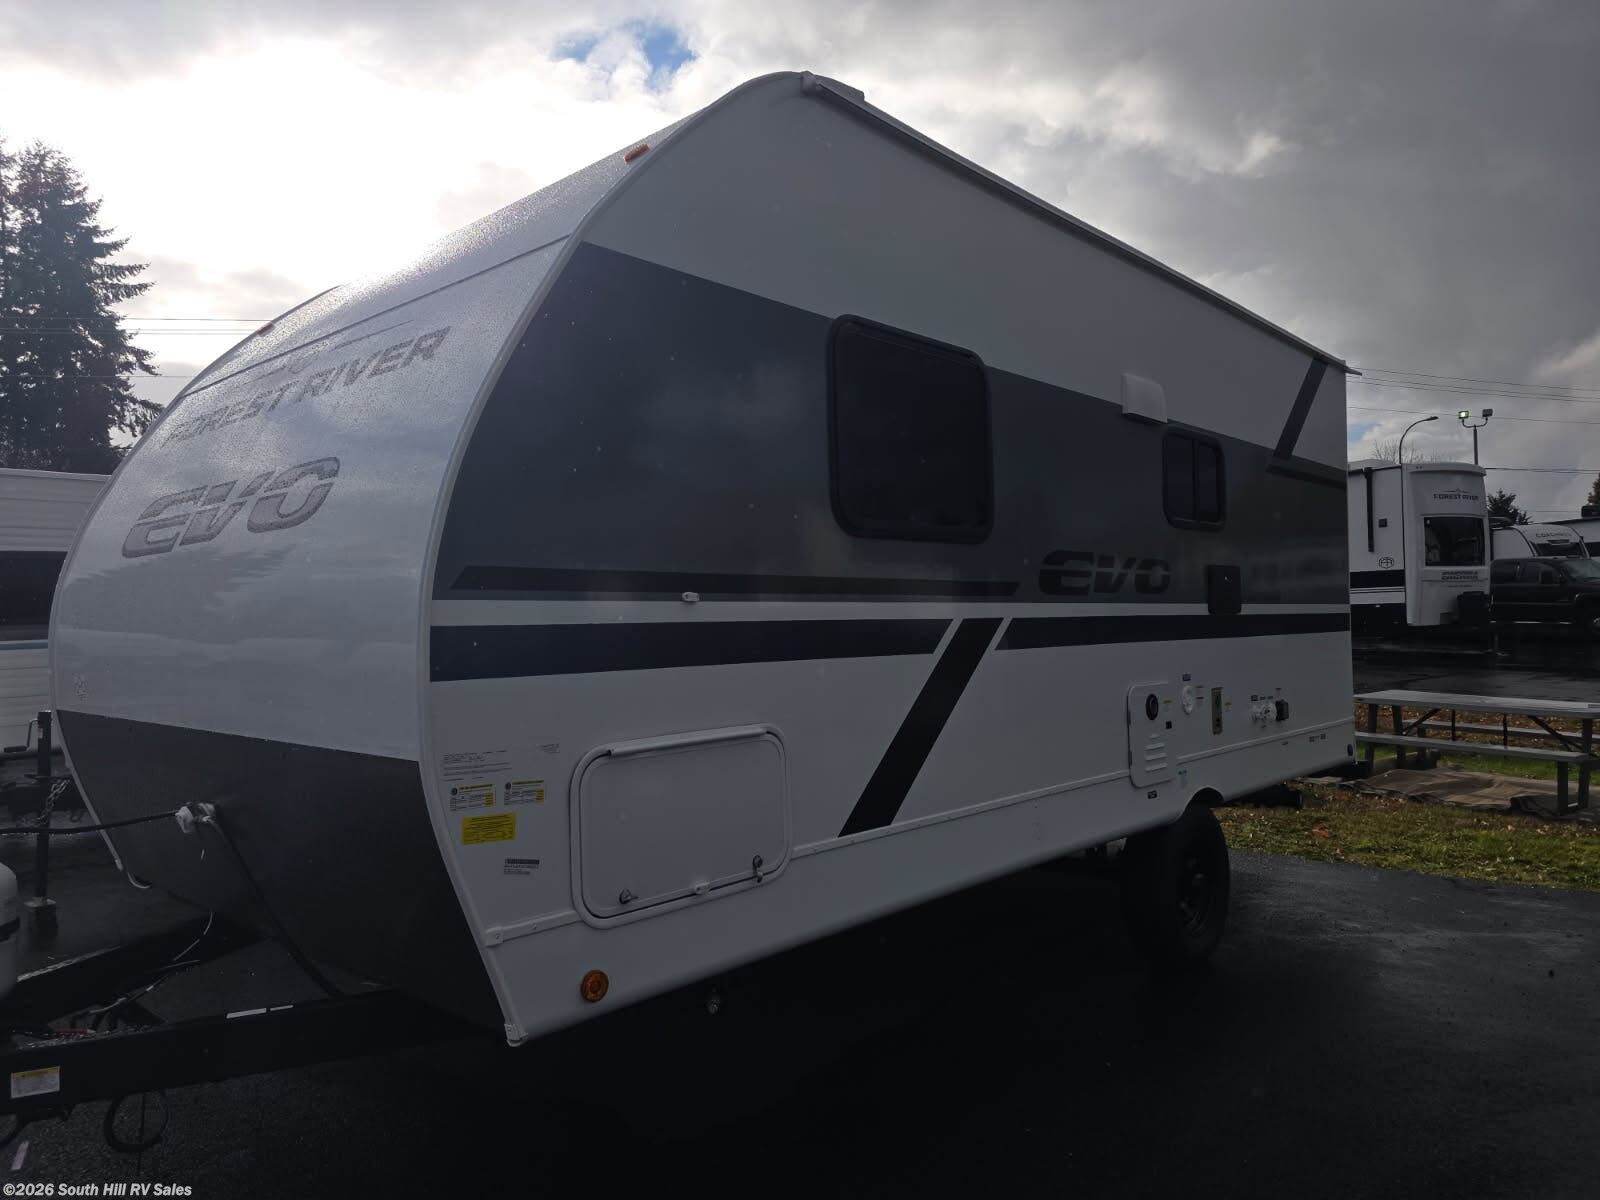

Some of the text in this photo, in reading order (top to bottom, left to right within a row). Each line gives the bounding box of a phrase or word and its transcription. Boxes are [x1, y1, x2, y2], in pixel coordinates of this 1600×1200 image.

[299, 326, 452, 402] RIVER
[121, 456, 340, 559] EVO
[1038, 549, 1171, 596] EVO
